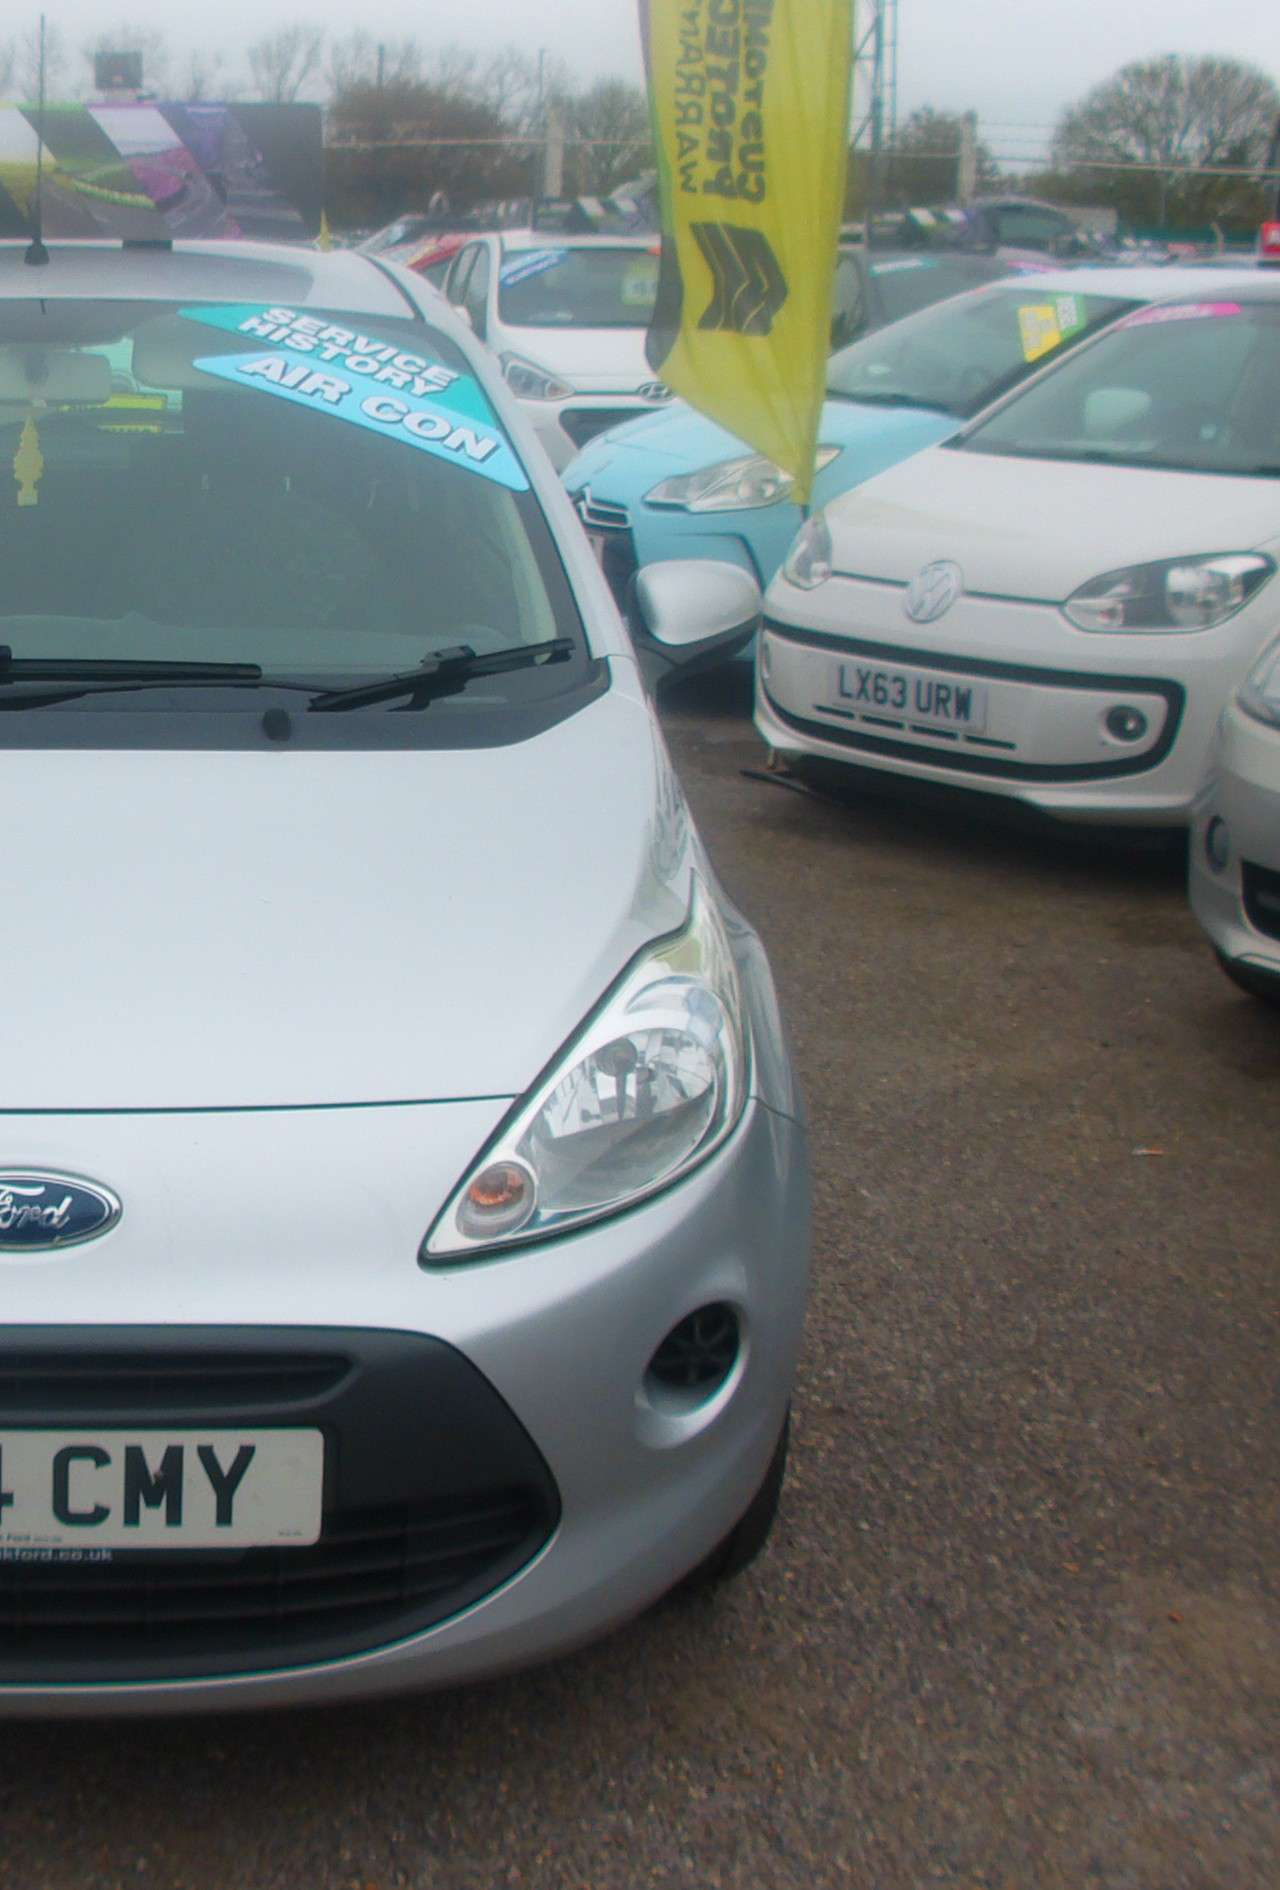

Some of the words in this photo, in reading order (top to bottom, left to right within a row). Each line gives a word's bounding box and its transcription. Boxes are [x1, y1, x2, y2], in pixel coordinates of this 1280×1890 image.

[237, 316, 451, 397] HISTORY
[261, 307, 460, 385] SERVICE
[237, 356, 352, 405] AIR
[360, 395, 498, 462] CON
[837, 664, 908, 709] LX63
[915, 678, 973, 722] URW
[52, 1445, 257, 1528] CMY
